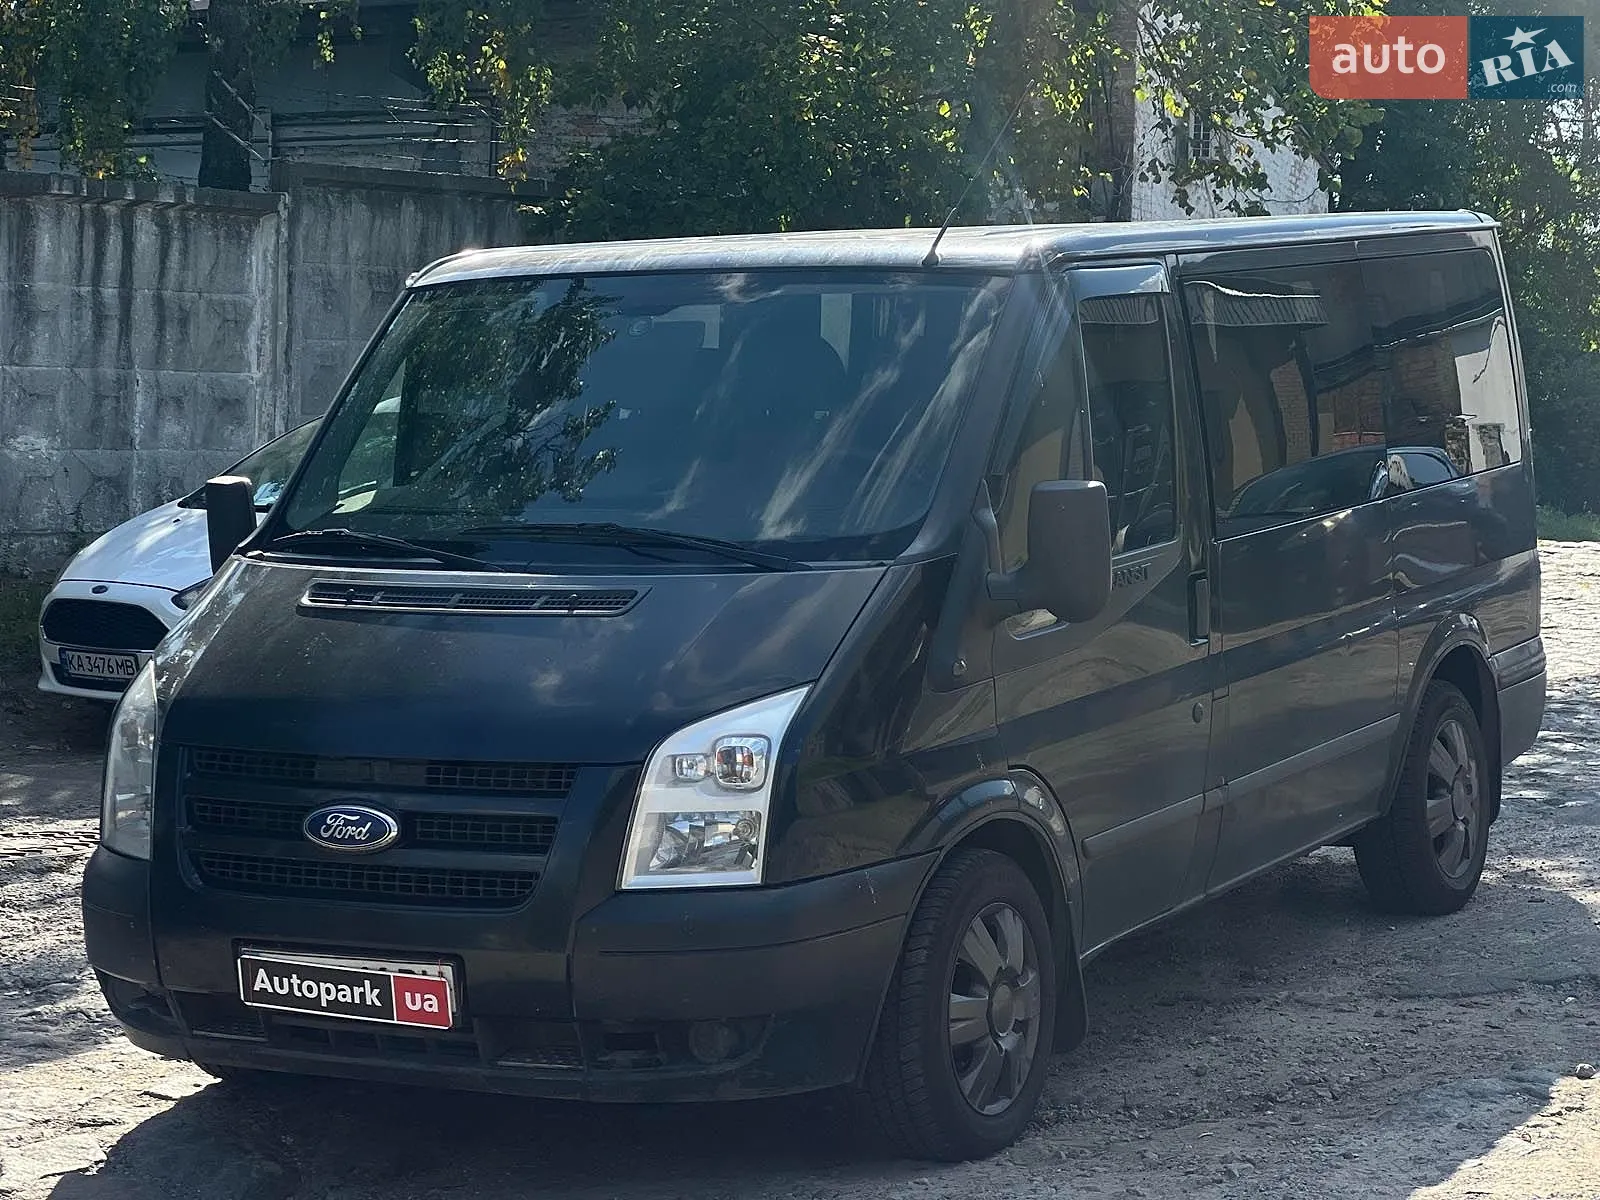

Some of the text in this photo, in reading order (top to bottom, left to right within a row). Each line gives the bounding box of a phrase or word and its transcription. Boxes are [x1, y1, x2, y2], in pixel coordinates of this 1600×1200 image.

[320, 813, 372, 840] Ford
[253, 968, 439, 1013] Autopark ua
